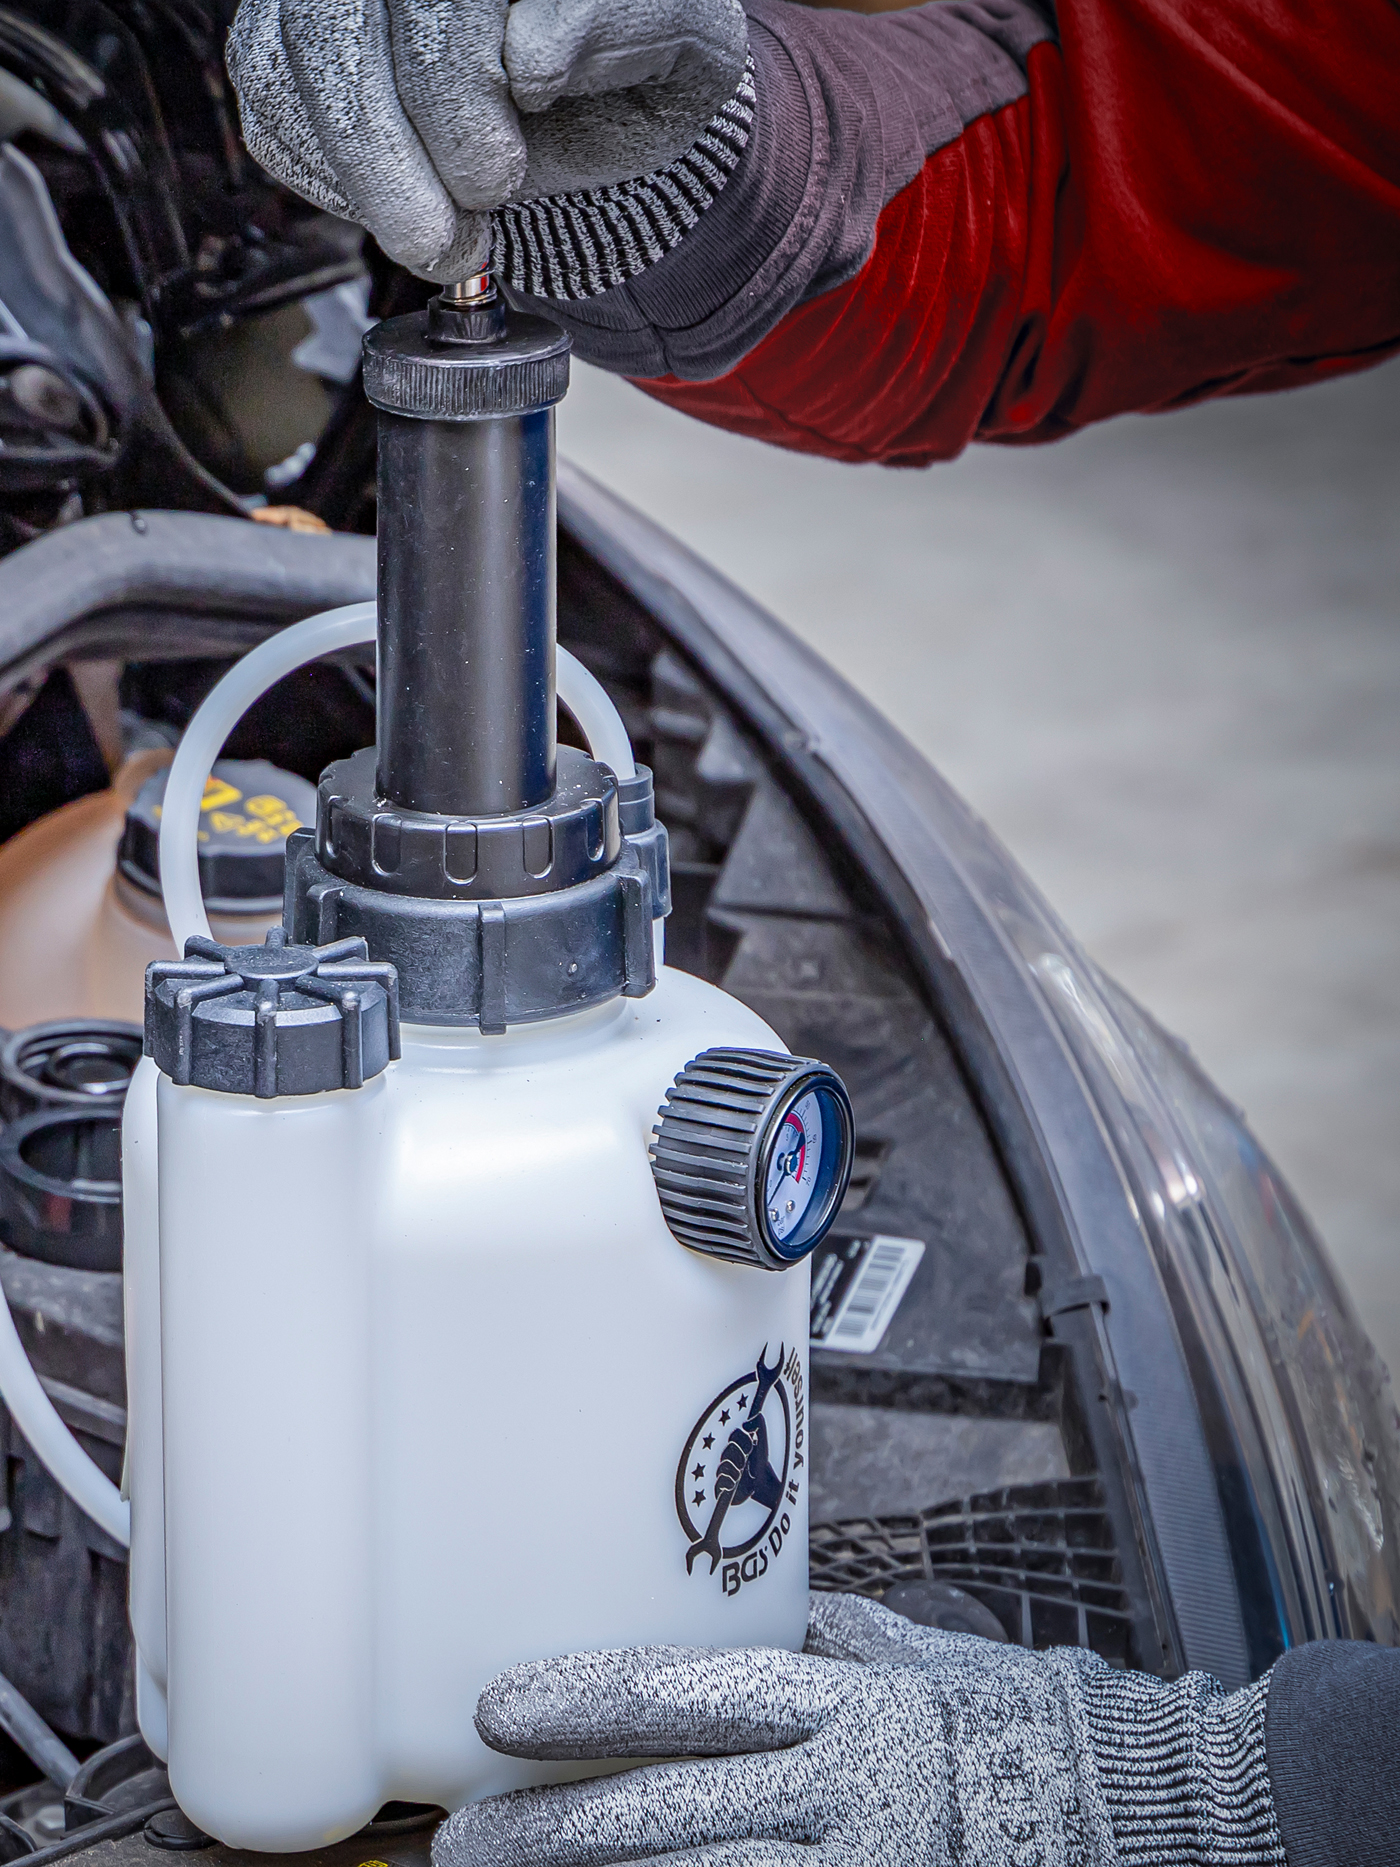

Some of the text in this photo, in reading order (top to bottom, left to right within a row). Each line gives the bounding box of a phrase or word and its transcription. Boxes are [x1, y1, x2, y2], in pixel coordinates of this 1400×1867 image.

[783, 1346, 805, 1470] yourself
[785, 1479, 800, 1506] it
[768, 1513, 791, 1557] Do
